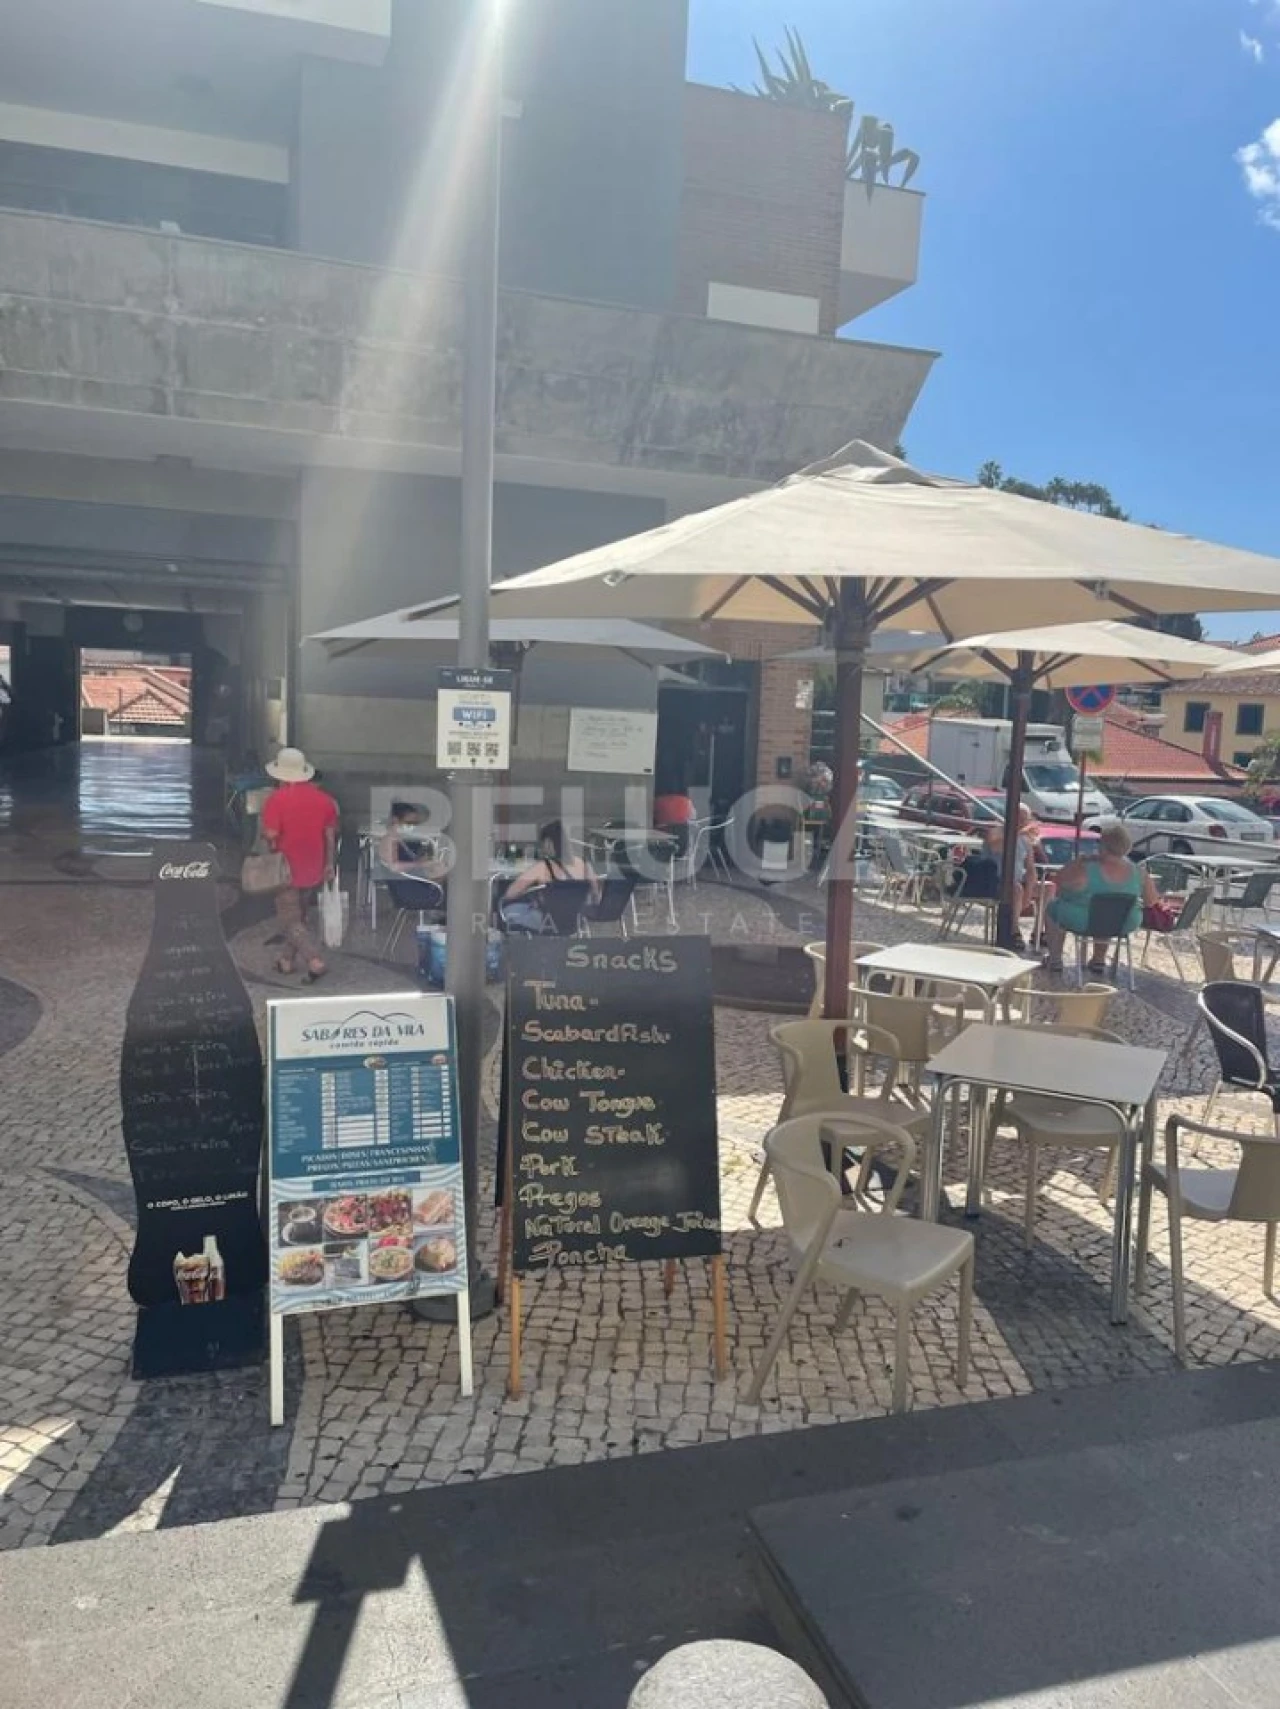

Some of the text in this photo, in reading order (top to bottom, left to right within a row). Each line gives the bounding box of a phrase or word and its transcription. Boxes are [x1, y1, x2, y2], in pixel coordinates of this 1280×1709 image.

[461, 709, 487, 719] WIFI
[159, 861, 211, 880] Coca-Cola
[372, 1025, 391, 1038] DA
[397, 1023, 425, 1037] VILA
[521, 1088, 570, 1111] Cow
[521, 1119, 569, 1143] Cow
